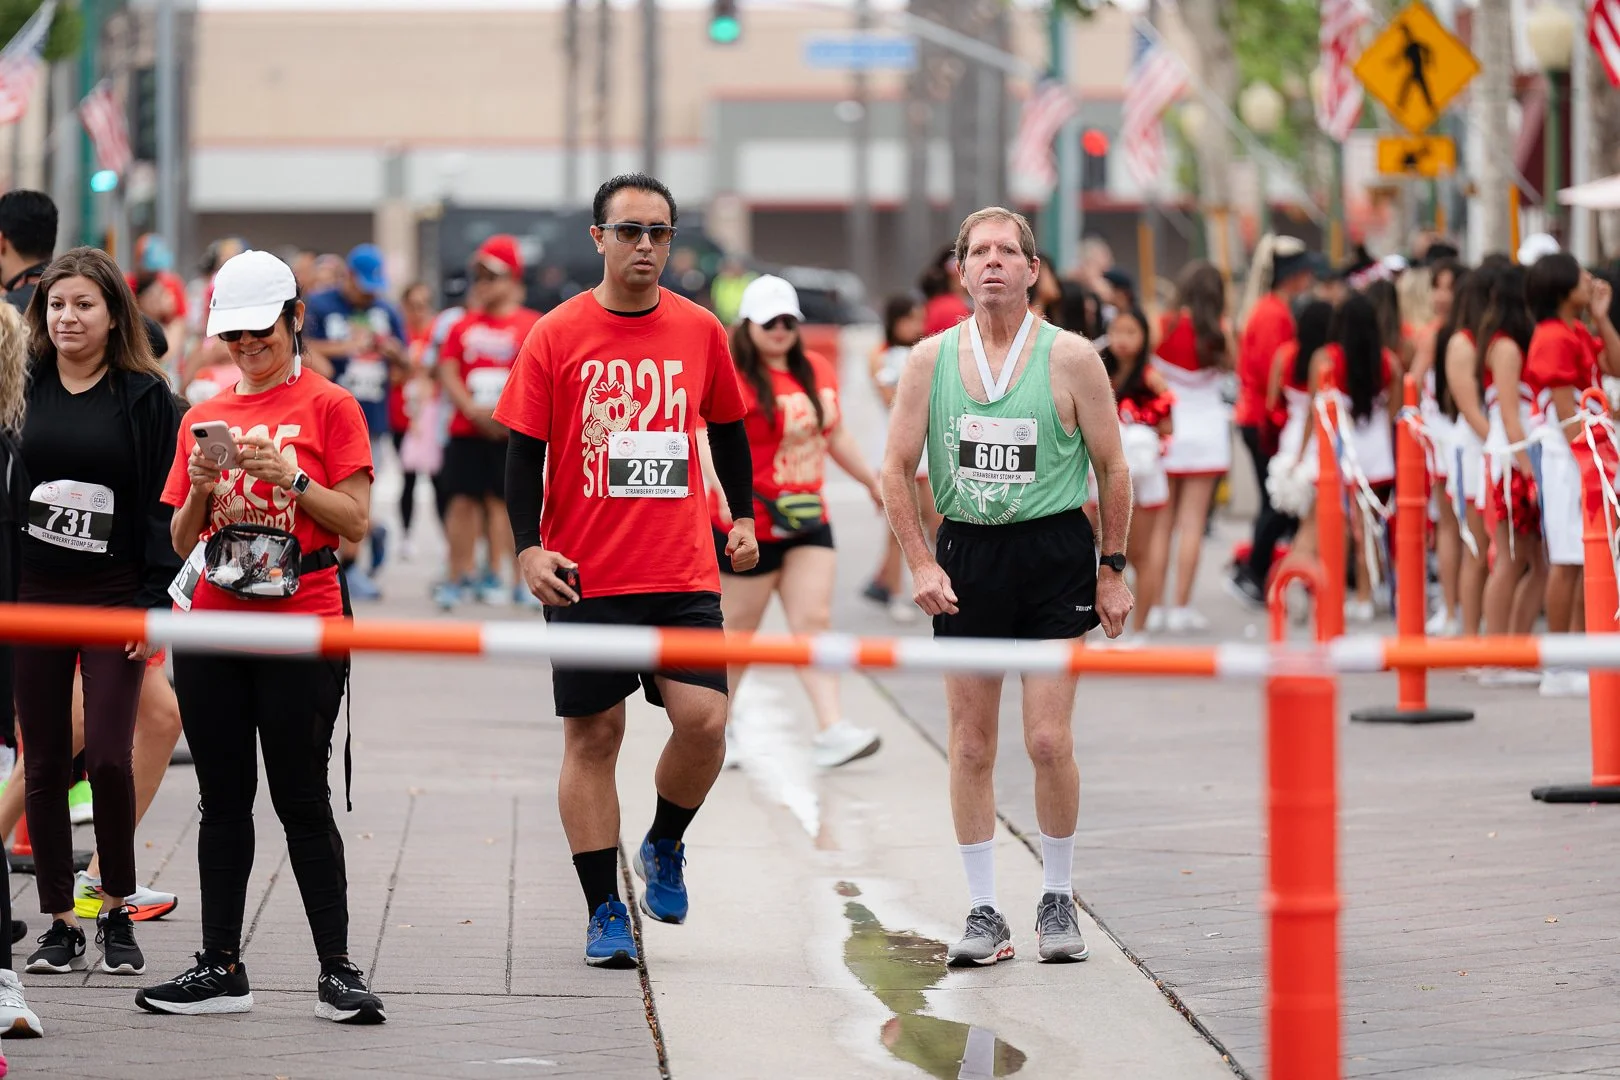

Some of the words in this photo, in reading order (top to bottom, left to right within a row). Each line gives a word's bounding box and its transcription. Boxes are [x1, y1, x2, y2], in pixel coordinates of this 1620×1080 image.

[975, 443, 1020, 471] 606
[627, 459, 674, 486] 267
[972, 471, 999, 480] STRAWBERRY
[45, 505, 92, 538] 731
[42, 531, 70, 545] STRAWBERRY
[70, 539, 86, 548] STOMP
